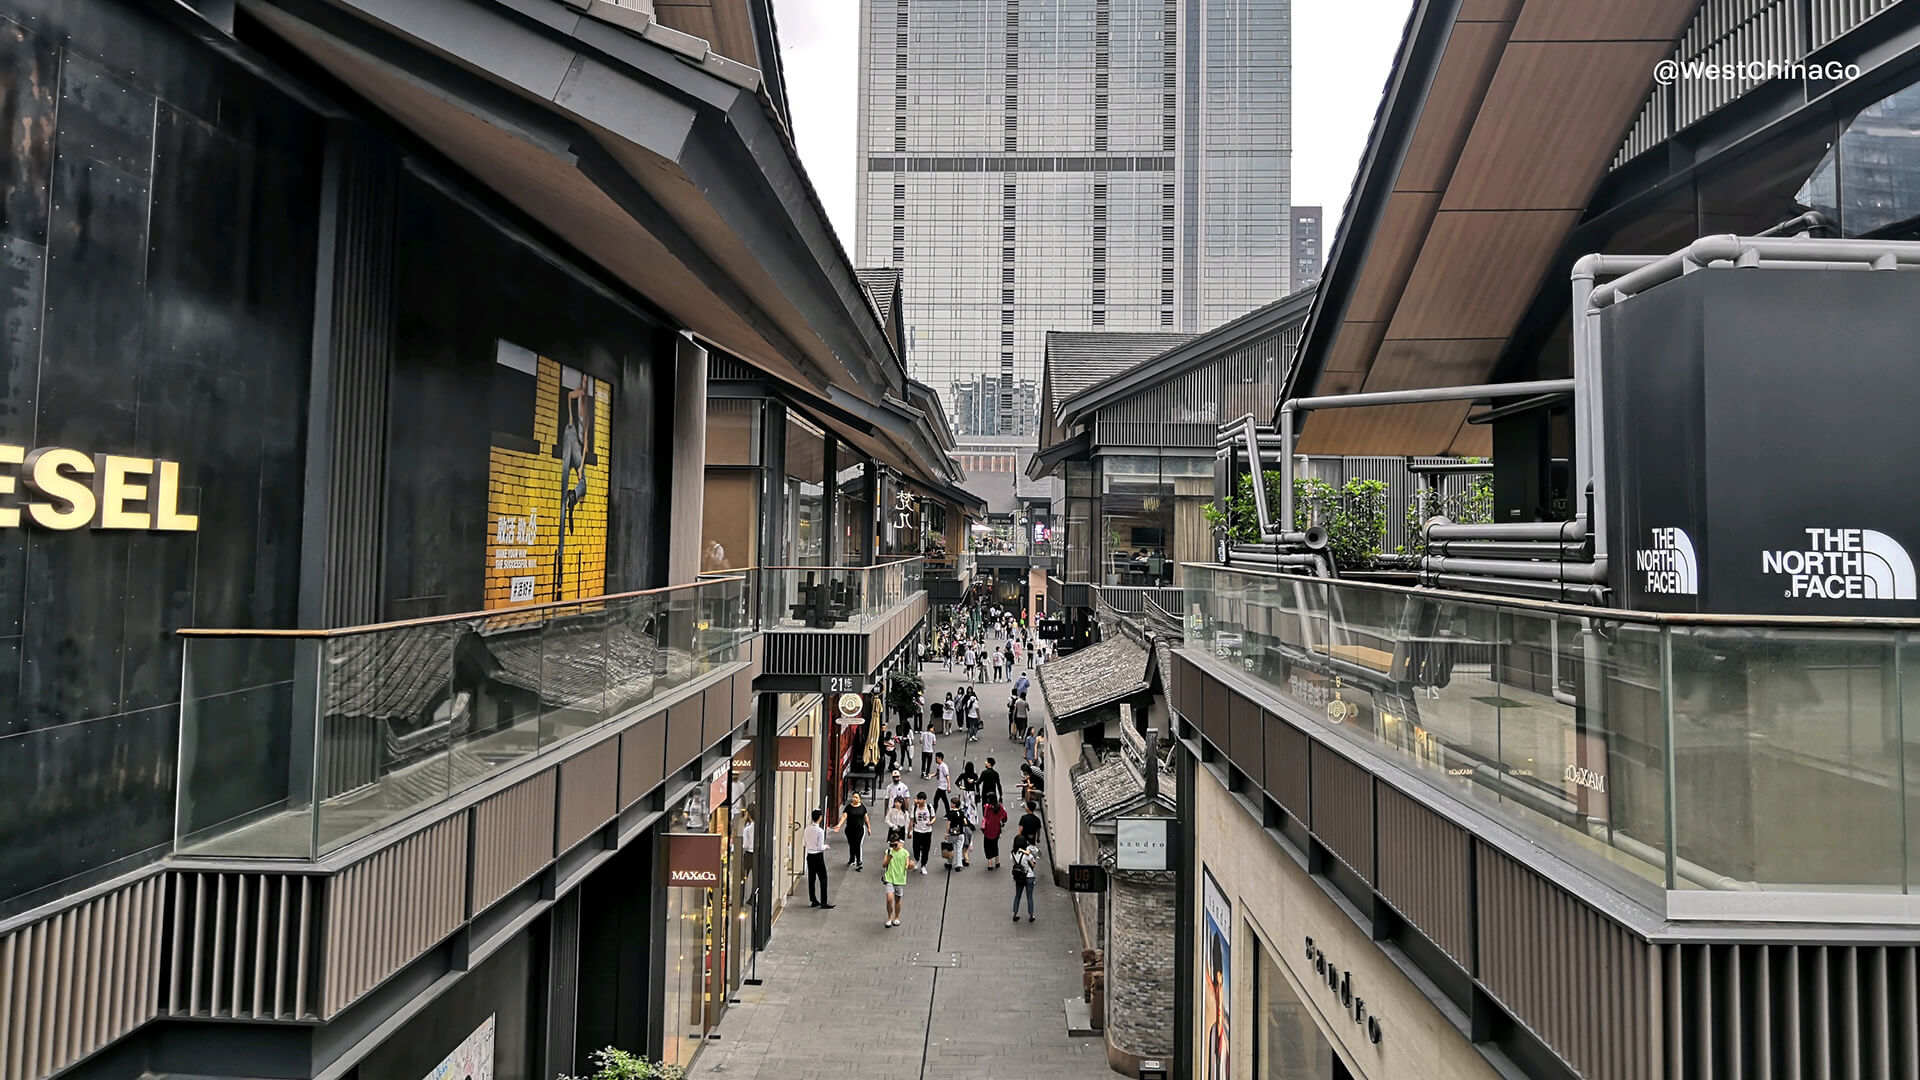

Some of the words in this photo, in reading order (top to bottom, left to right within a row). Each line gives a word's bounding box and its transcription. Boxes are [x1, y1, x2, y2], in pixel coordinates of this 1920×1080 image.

[1652, 528, 1675, 549] THE
[1805, 528, 1862, 552] THE
[1636, 549, 1675, 571] NORTH
[1762, 550, 1862, 575] NORTH
[1647, 571, 1676, 594] FACE
[1791, 575, 1863, 599] FACE
[1119, 840, 1166, 848] sandro
[1305, 936, 1381, 1045] sandro
